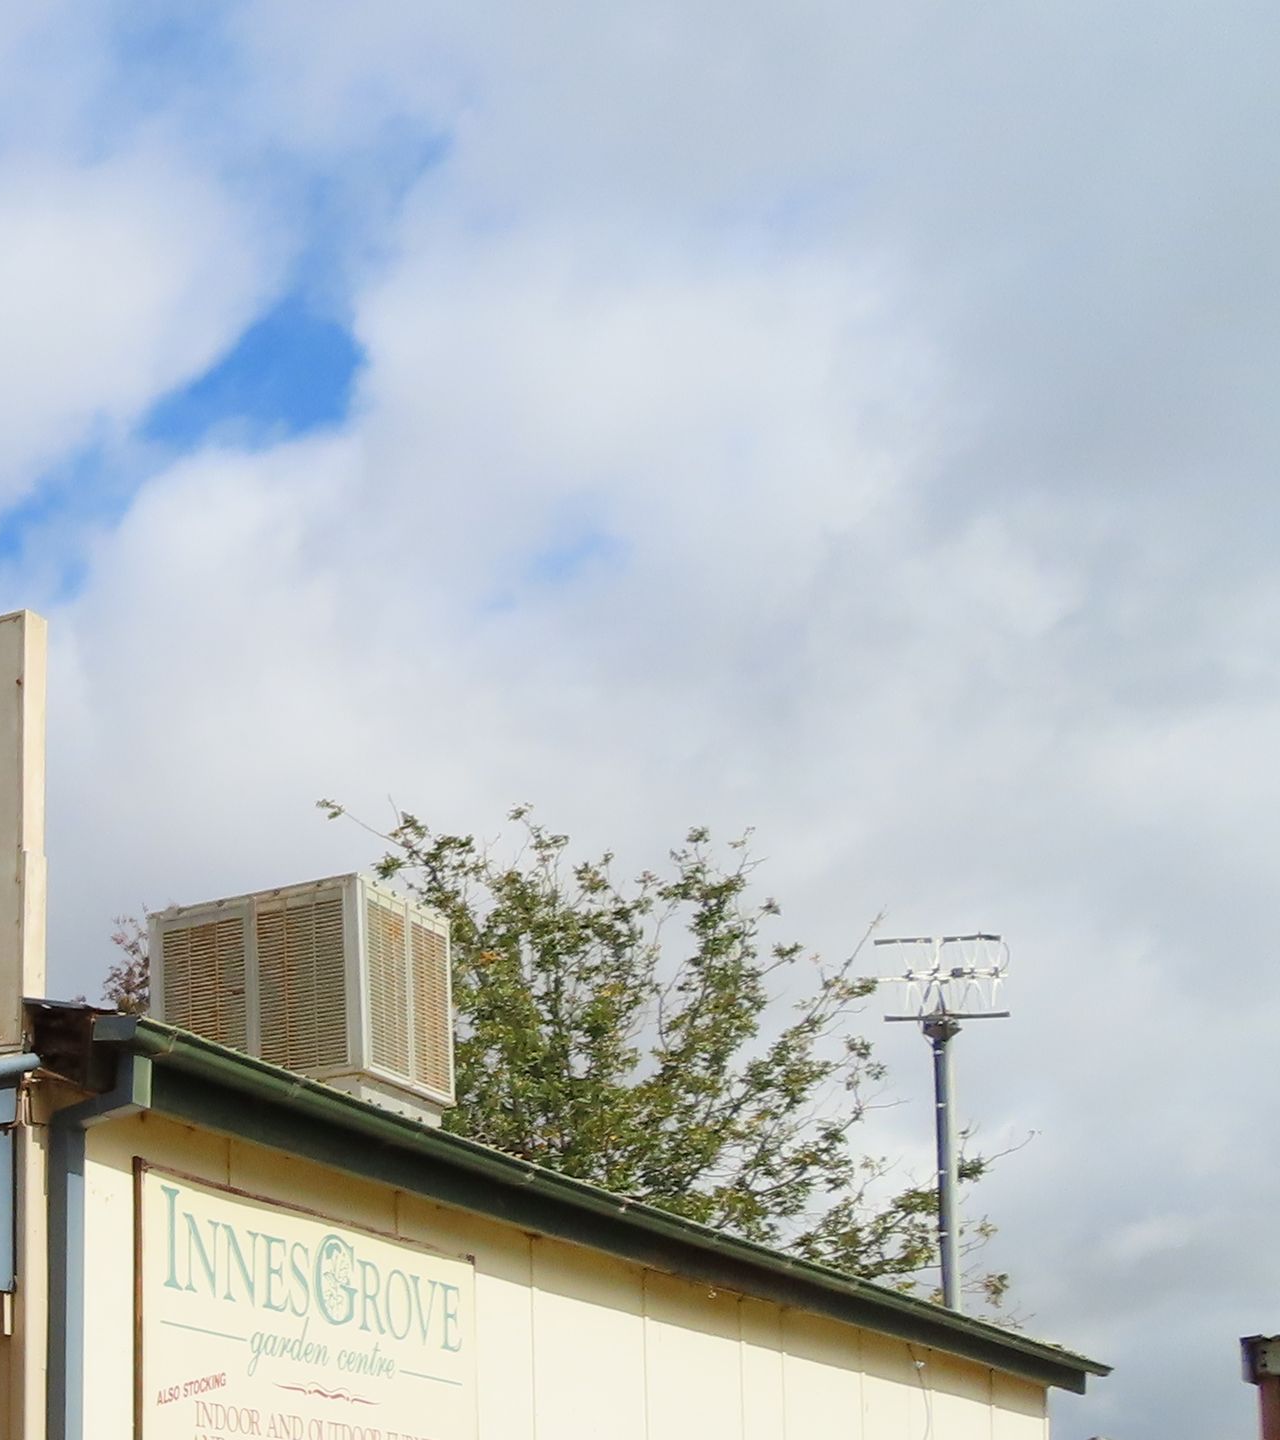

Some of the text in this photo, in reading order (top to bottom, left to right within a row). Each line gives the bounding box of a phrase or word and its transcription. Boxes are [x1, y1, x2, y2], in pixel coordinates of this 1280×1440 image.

[160, 1184, 462, 1352] INNESGROVE
[249, 1316, 397, 1379] garden centre
[156, 1372, 227, 1406] ALSO STOCKING
[194, 1400, 262, 1436] INDOOR
